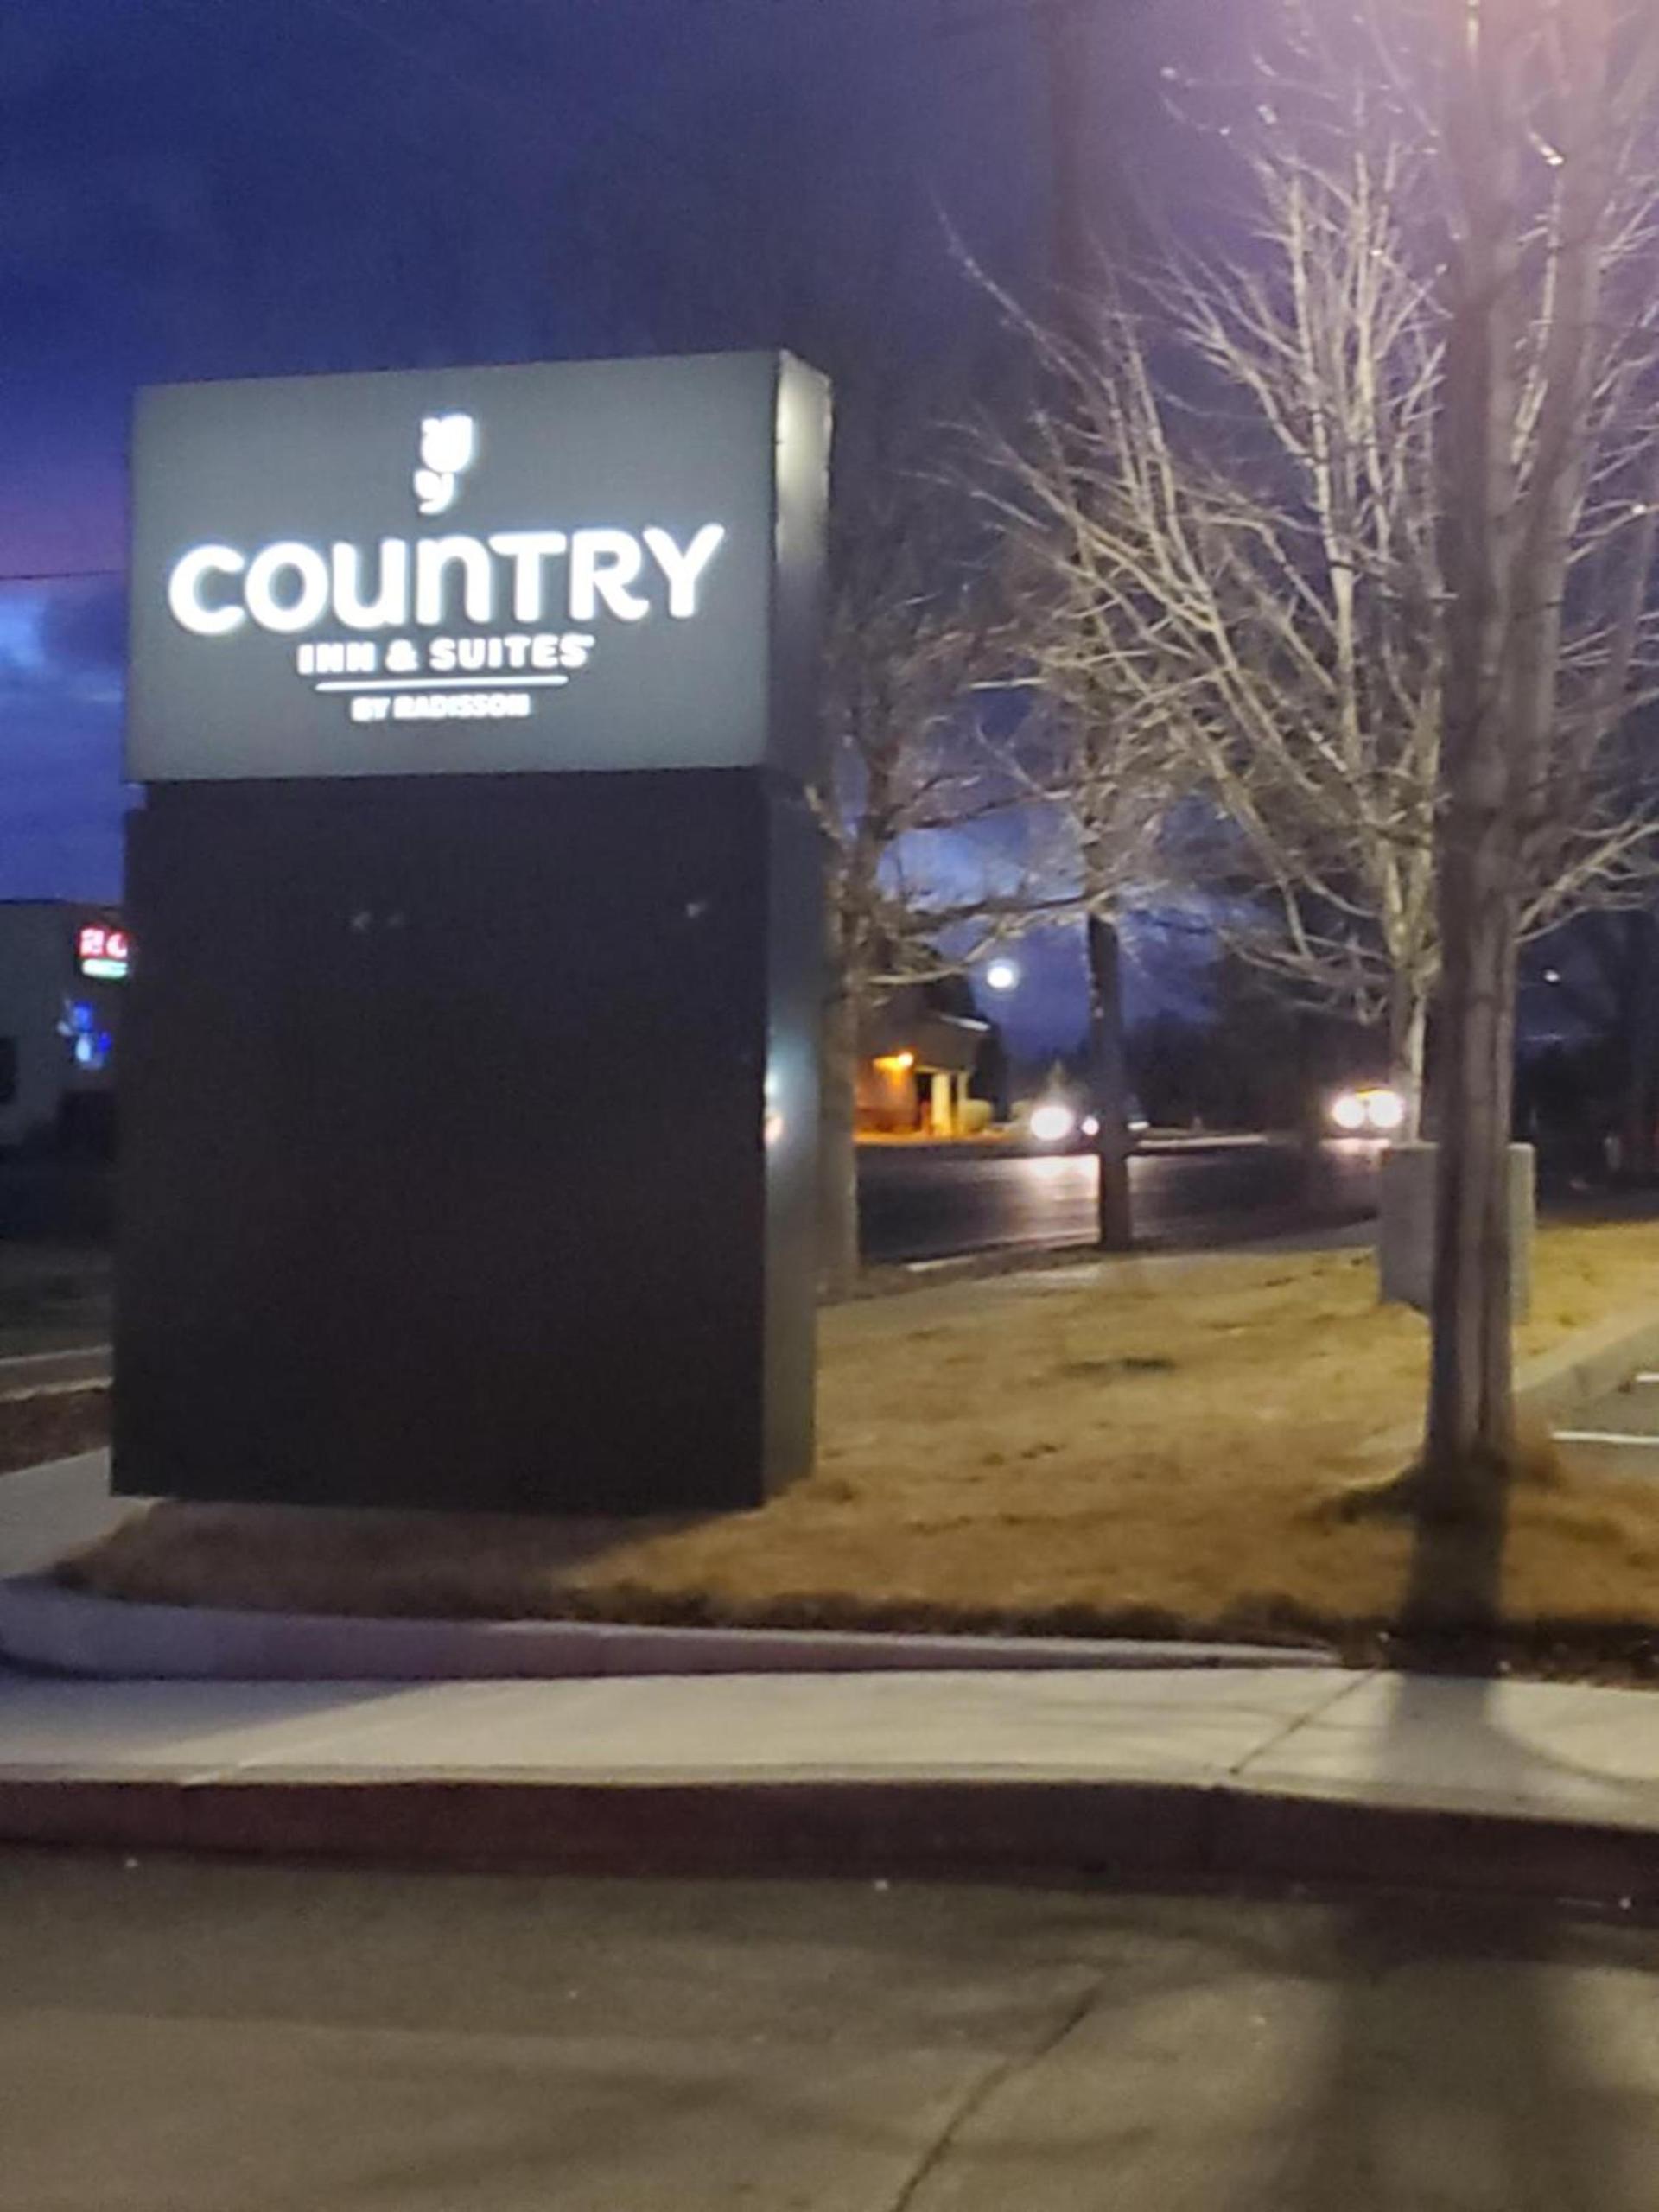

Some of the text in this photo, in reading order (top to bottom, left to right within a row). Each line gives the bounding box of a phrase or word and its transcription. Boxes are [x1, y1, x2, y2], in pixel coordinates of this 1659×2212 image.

[168, 524, 725, 634] COUNTRY
[298, 635, 591, 675] INN & SUITES
[351, 696, 389, 721] BY
